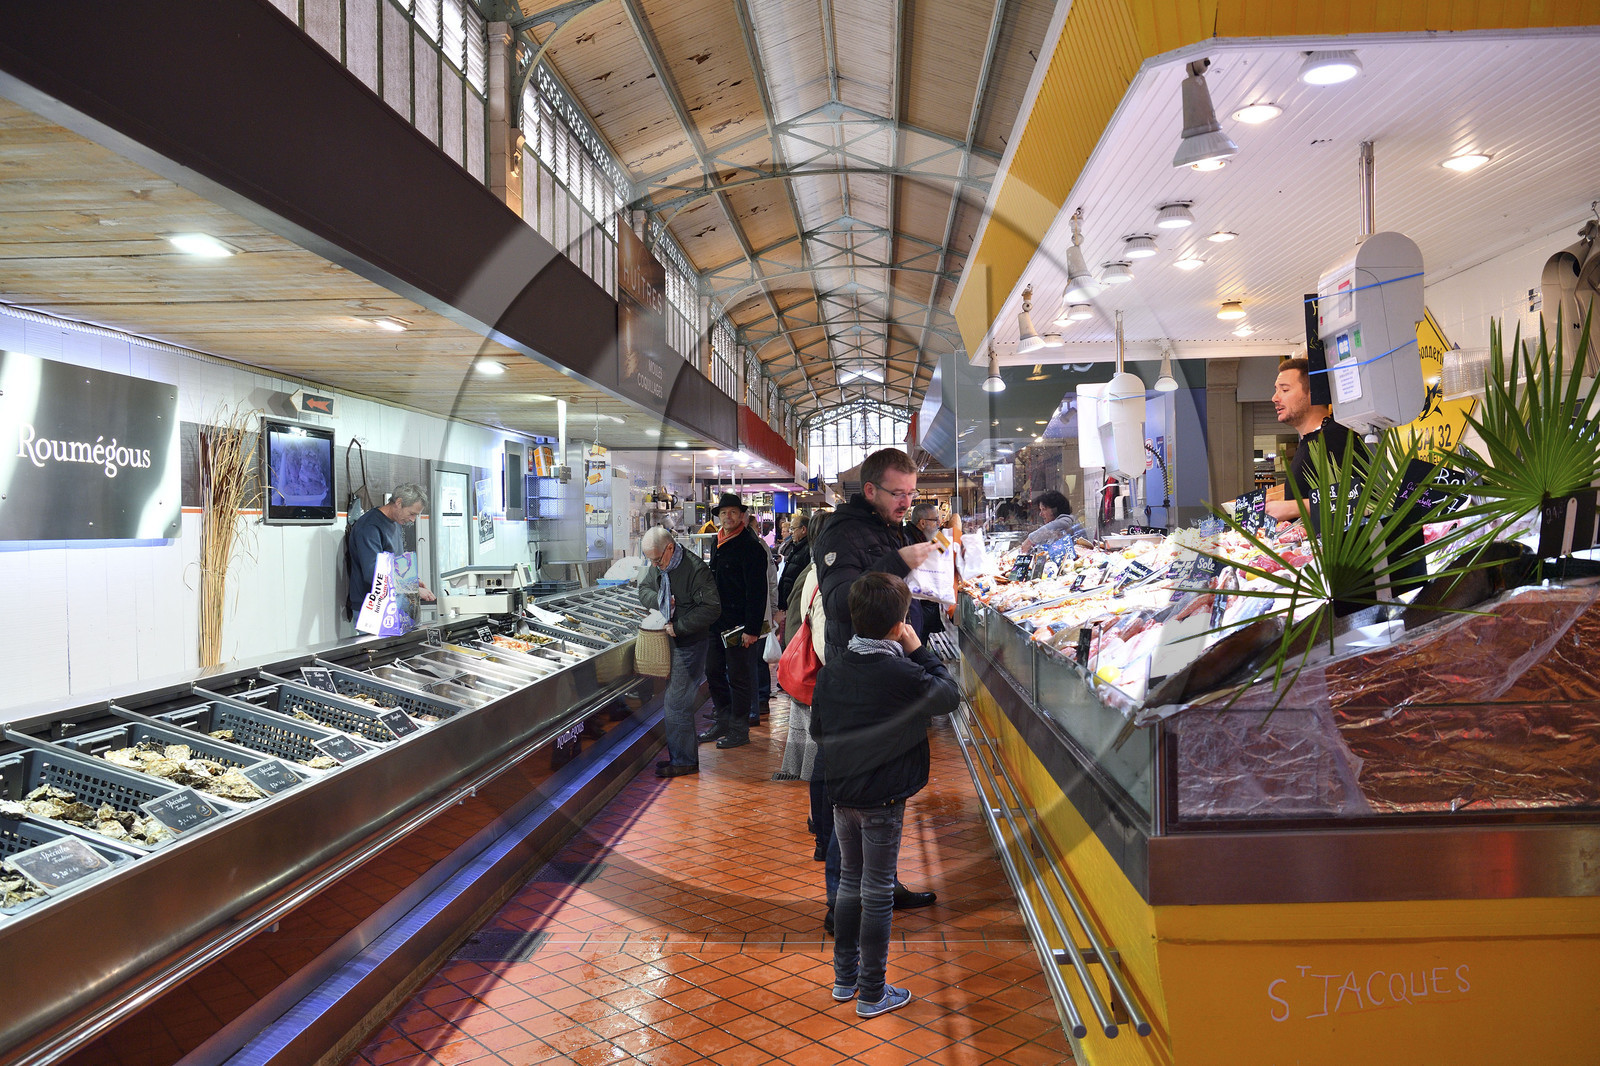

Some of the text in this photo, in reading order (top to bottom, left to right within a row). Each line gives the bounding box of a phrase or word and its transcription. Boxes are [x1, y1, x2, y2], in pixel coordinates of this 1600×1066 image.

[623, 265, 663, 316] HUÎTRES
[16, 423, 151, 478] Roumégous
[1438, 424, 1452, 448] 32
[1197, 557, 1216, 571] Sole
[1306, 964, 1471, 1019] JACQUES
